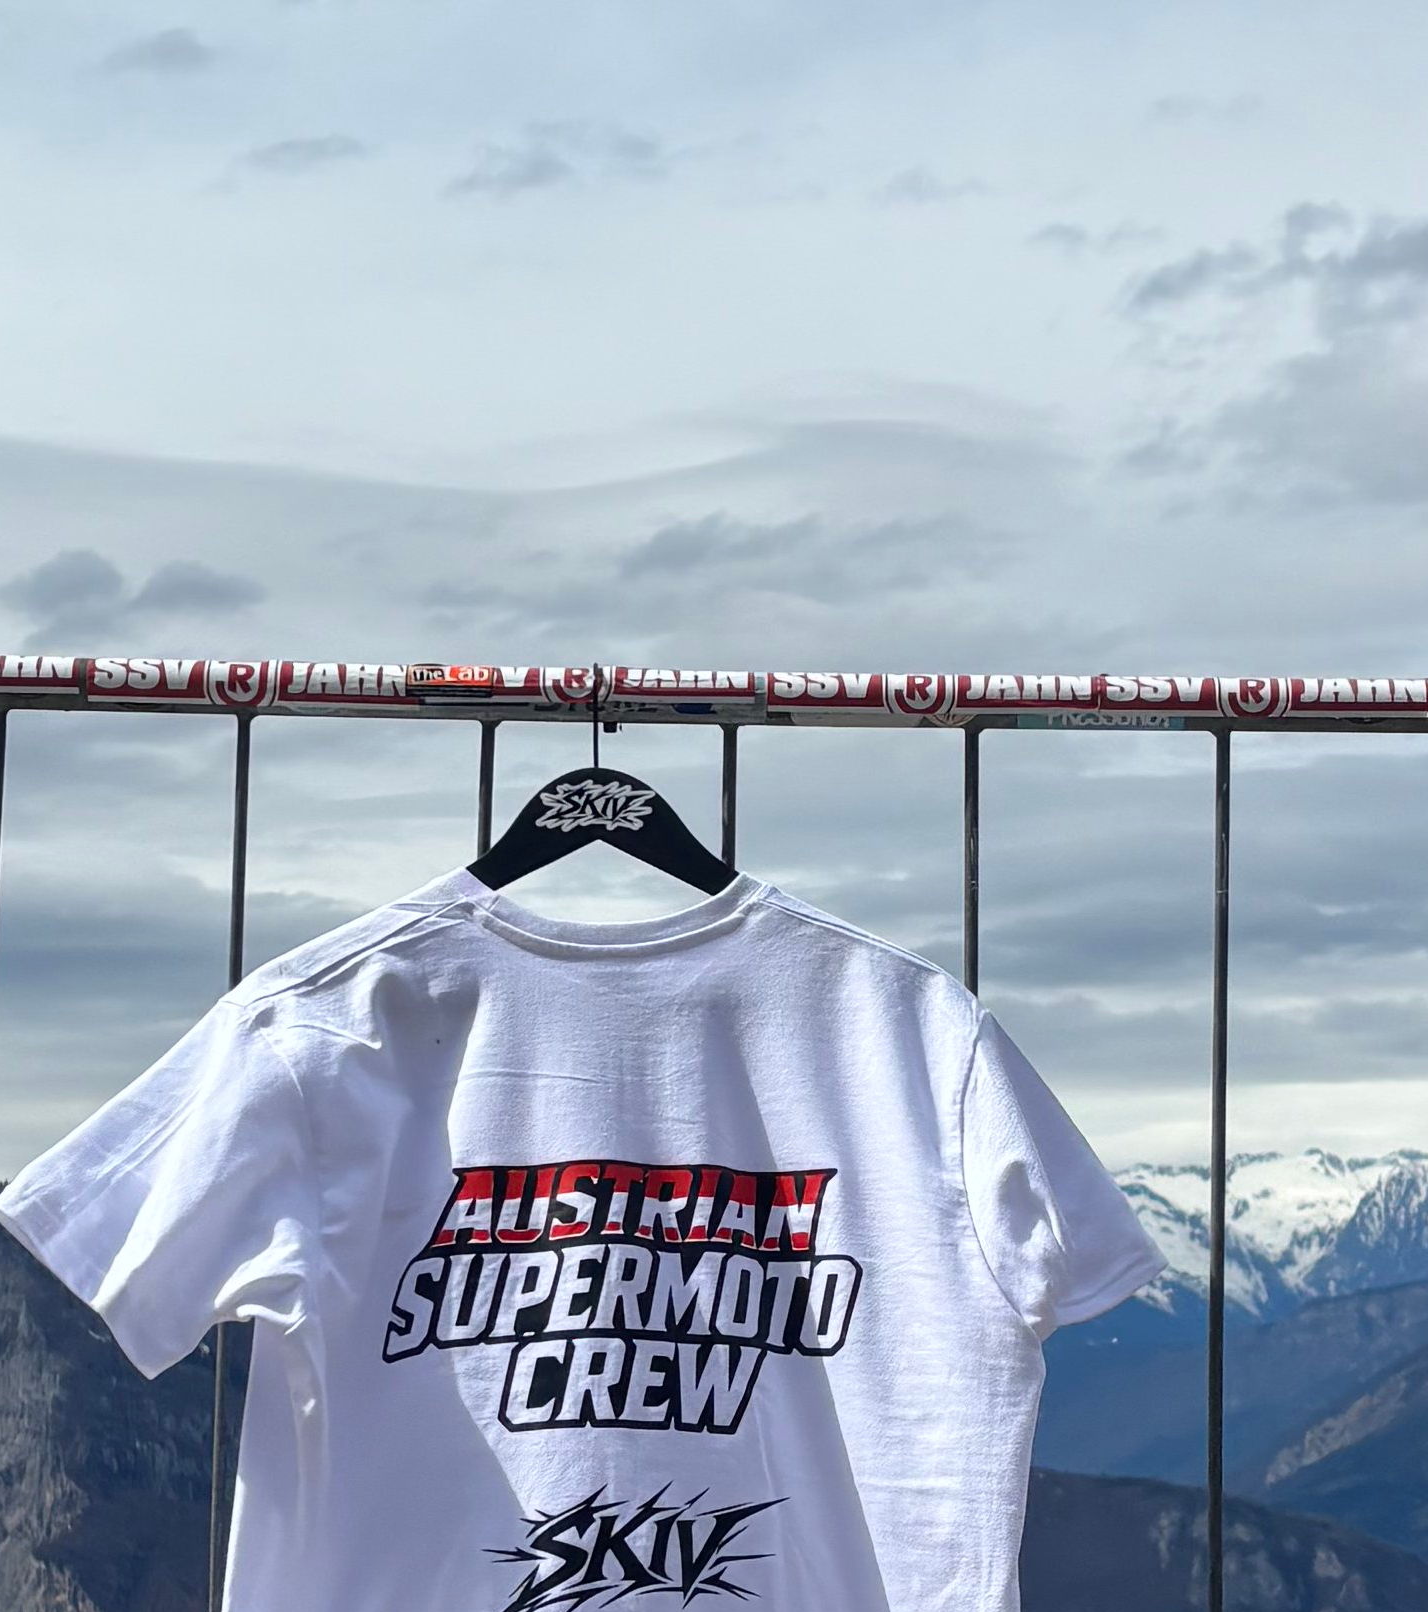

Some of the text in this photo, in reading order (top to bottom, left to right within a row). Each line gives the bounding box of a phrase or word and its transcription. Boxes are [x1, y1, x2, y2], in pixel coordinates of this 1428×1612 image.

[93, 658, 194, 689] SSV
[773, 672, 873, 698] SSV
[1106, 676, 1204, 702] SSV
[542, 783, 649, 829] SKIV
[427, 1160, 837, 1253] AUSTRIAN
[381, 1240, 863, 1363] SUPERMOTO
[498, 1336, 767, 1434] CREW
